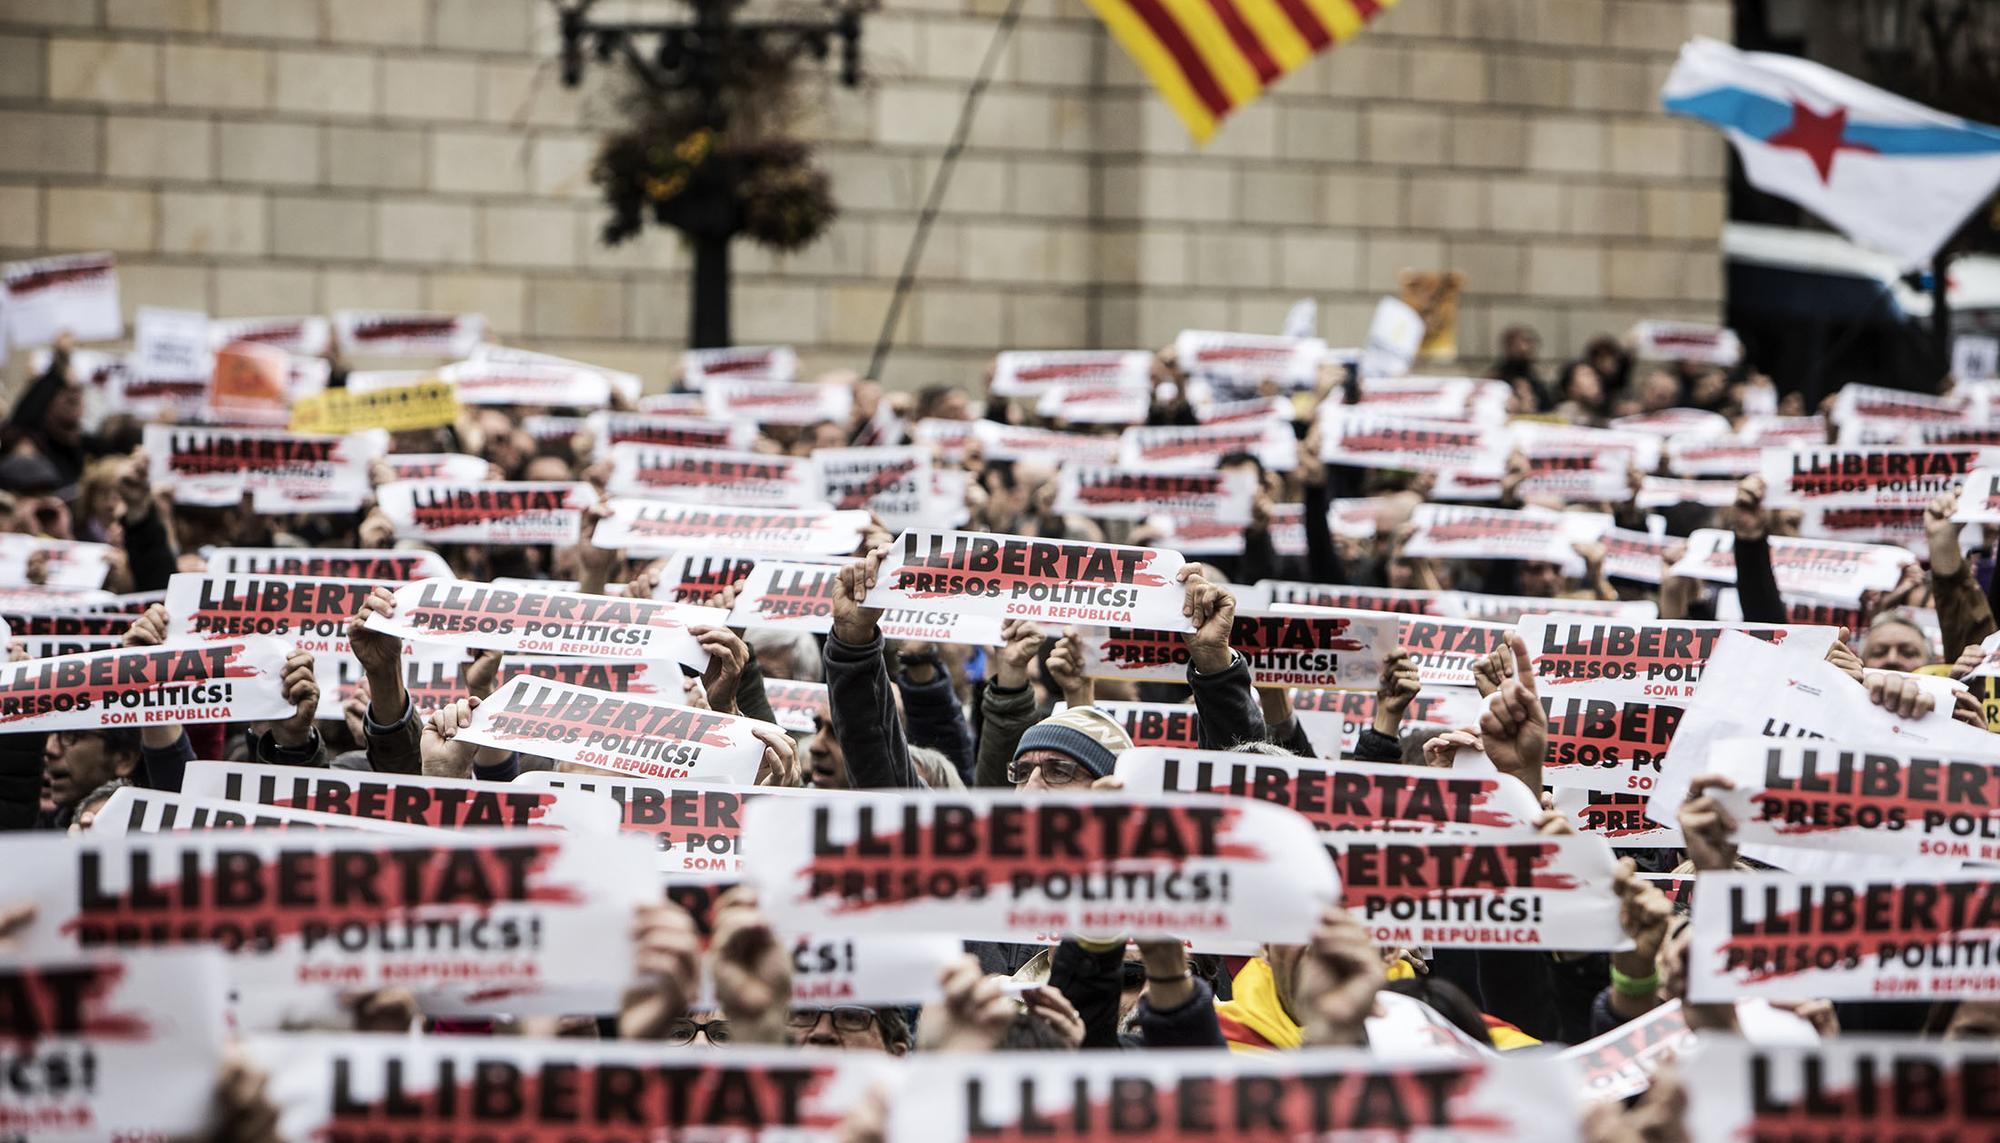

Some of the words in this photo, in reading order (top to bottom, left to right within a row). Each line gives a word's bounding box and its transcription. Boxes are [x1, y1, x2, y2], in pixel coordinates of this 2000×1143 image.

[1793, 452, 1972, 476] LLIBERTAT
[903, 533, 1144, 584] LLIBERTAT
[199, 579, 394, 615] LLIBERT
[418, 583, 663, 625] LLIBERTAT
[899, 571, 1000, 597] PRESOS
[1011, 579, 1137, 608] POLÍTICS!
[759, 601, 832, 618] PRESO
[1006, 603, 1042, 616] SOM
[1048, 604, 1131, 622] REPÚBLICA
[196, 615, 289, 637] PRESOS
[411, 612, 513, 635] PRESOS
[523, 620, 652, 646] POLÍTICS!
[1542, 624, 1777, 659] LLIBERT
[296, 640, 328, 651] SOM
[518, 639, 553, 651] SOM
[560, 642, 642, 657] REPÚBLICA
[1248, 649, 1338, 672] LÍTICS!
[0, 646, 233, 692] LIBERTAT
[1256, 671, 1336, 685] REPÚBLICA
[1539, 659, 1637, 680] PRESOS
[0, 692, 91, 716] RESOS
[102, 682, 232, 709] POLÍTICS!
[1644, 685, 1678, 697] SOM
[101, 712, 137, 725] SOM
[145, 706, 232, 722] REPÚBLICA
[504, 682, 725, 746] LLIBERTAT
[1540, 697, 1686, 745] LIBER
[493, 716, 577, 744] PRESOS
[584, 730, 701, 767] POLÍTICS!
[1546, 741, 1620, 768] ESOS
[575, 750, 608, 766] SOM
[612, 757, 689, 779] REPÚBLICA
[1765, 748, 2000, 805] LLIBER
[1163, 760, 1482, 823] LLIBERTAT
[1627, 776, 1653, 790] SO
[1761, 799, 1906, 831] PRESOS
[815, 804, 1228, 858] LLIBERTAT
[80, 843, 541, 909] LLIBERTAT
[683, 857, 726, 871] SOM
[1325, 842, 1543, 888] ERTAT
[809, 869, 988, 899] PRESOS
[1366, 892, 1542, 922] POLÍTICS!
[1423, 923, 1540, 943] REPÚBLICA
[1725, 942, 1861, 972] PRESOS
[333, 1056, 814, 1127] LLIBERTAT
[966, 1068, 1468, 1138] LLIBERTAT
